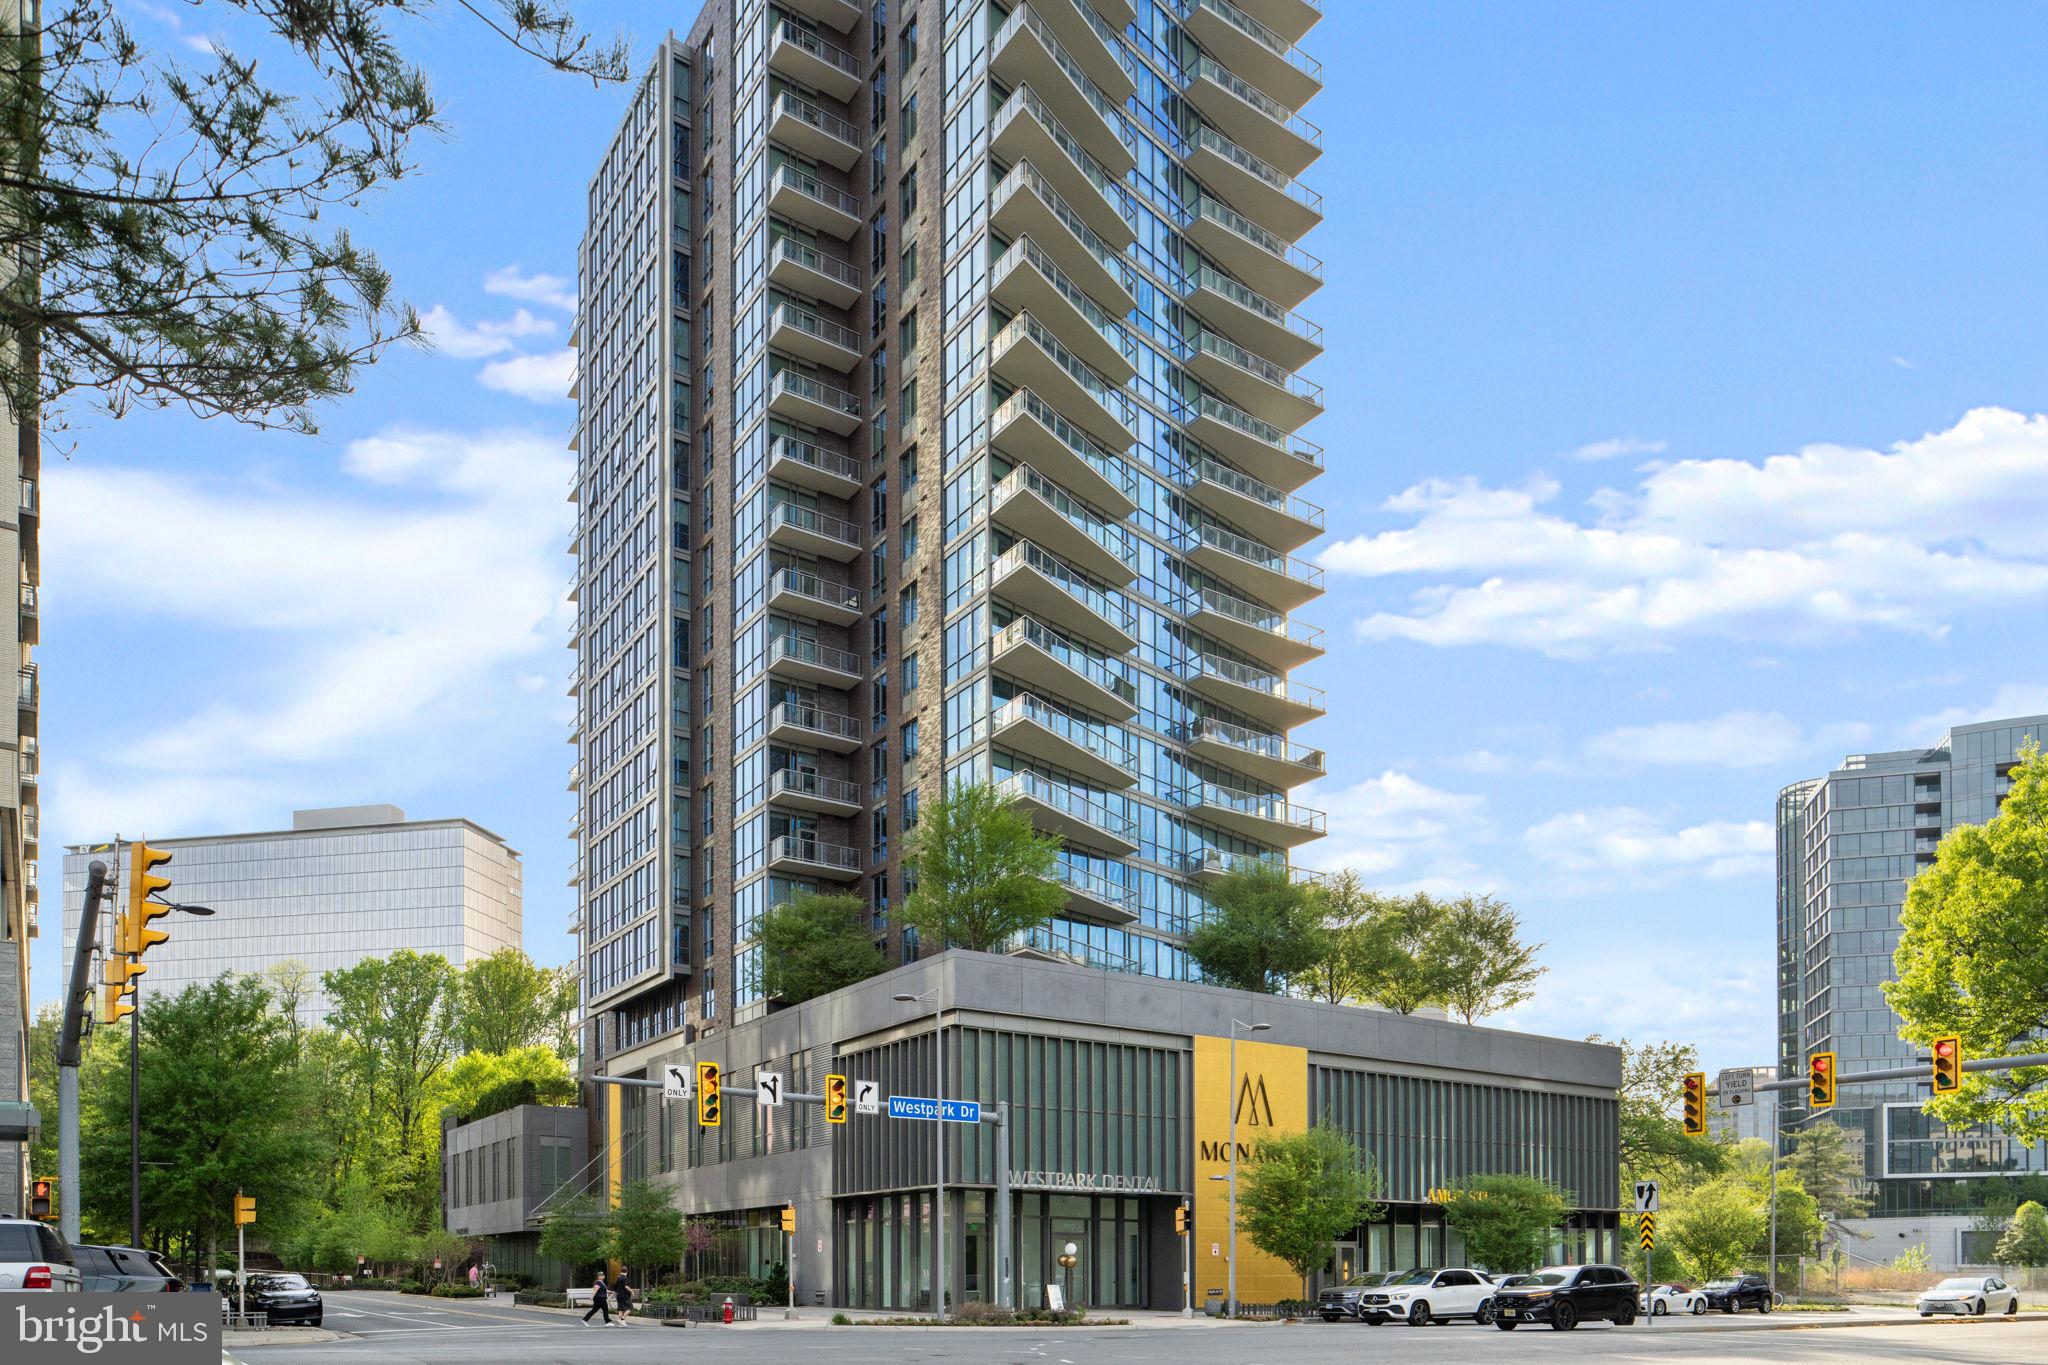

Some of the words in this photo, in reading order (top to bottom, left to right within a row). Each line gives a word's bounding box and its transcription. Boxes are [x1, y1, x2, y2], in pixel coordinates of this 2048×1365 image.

[1726, 1080, 1747, 1088] YIELD
[667, 1088, 688, 1097] ONLY
[858, 1103, 875, 1111] ONLY
[961, 1105, 975, 1118] Dr
[1200, 1140, 1280, 1163] MONA
[1009, 1169, 1097, 1191] WESTPARK
[1102, 1174, 1161, 1193] DENTAL
